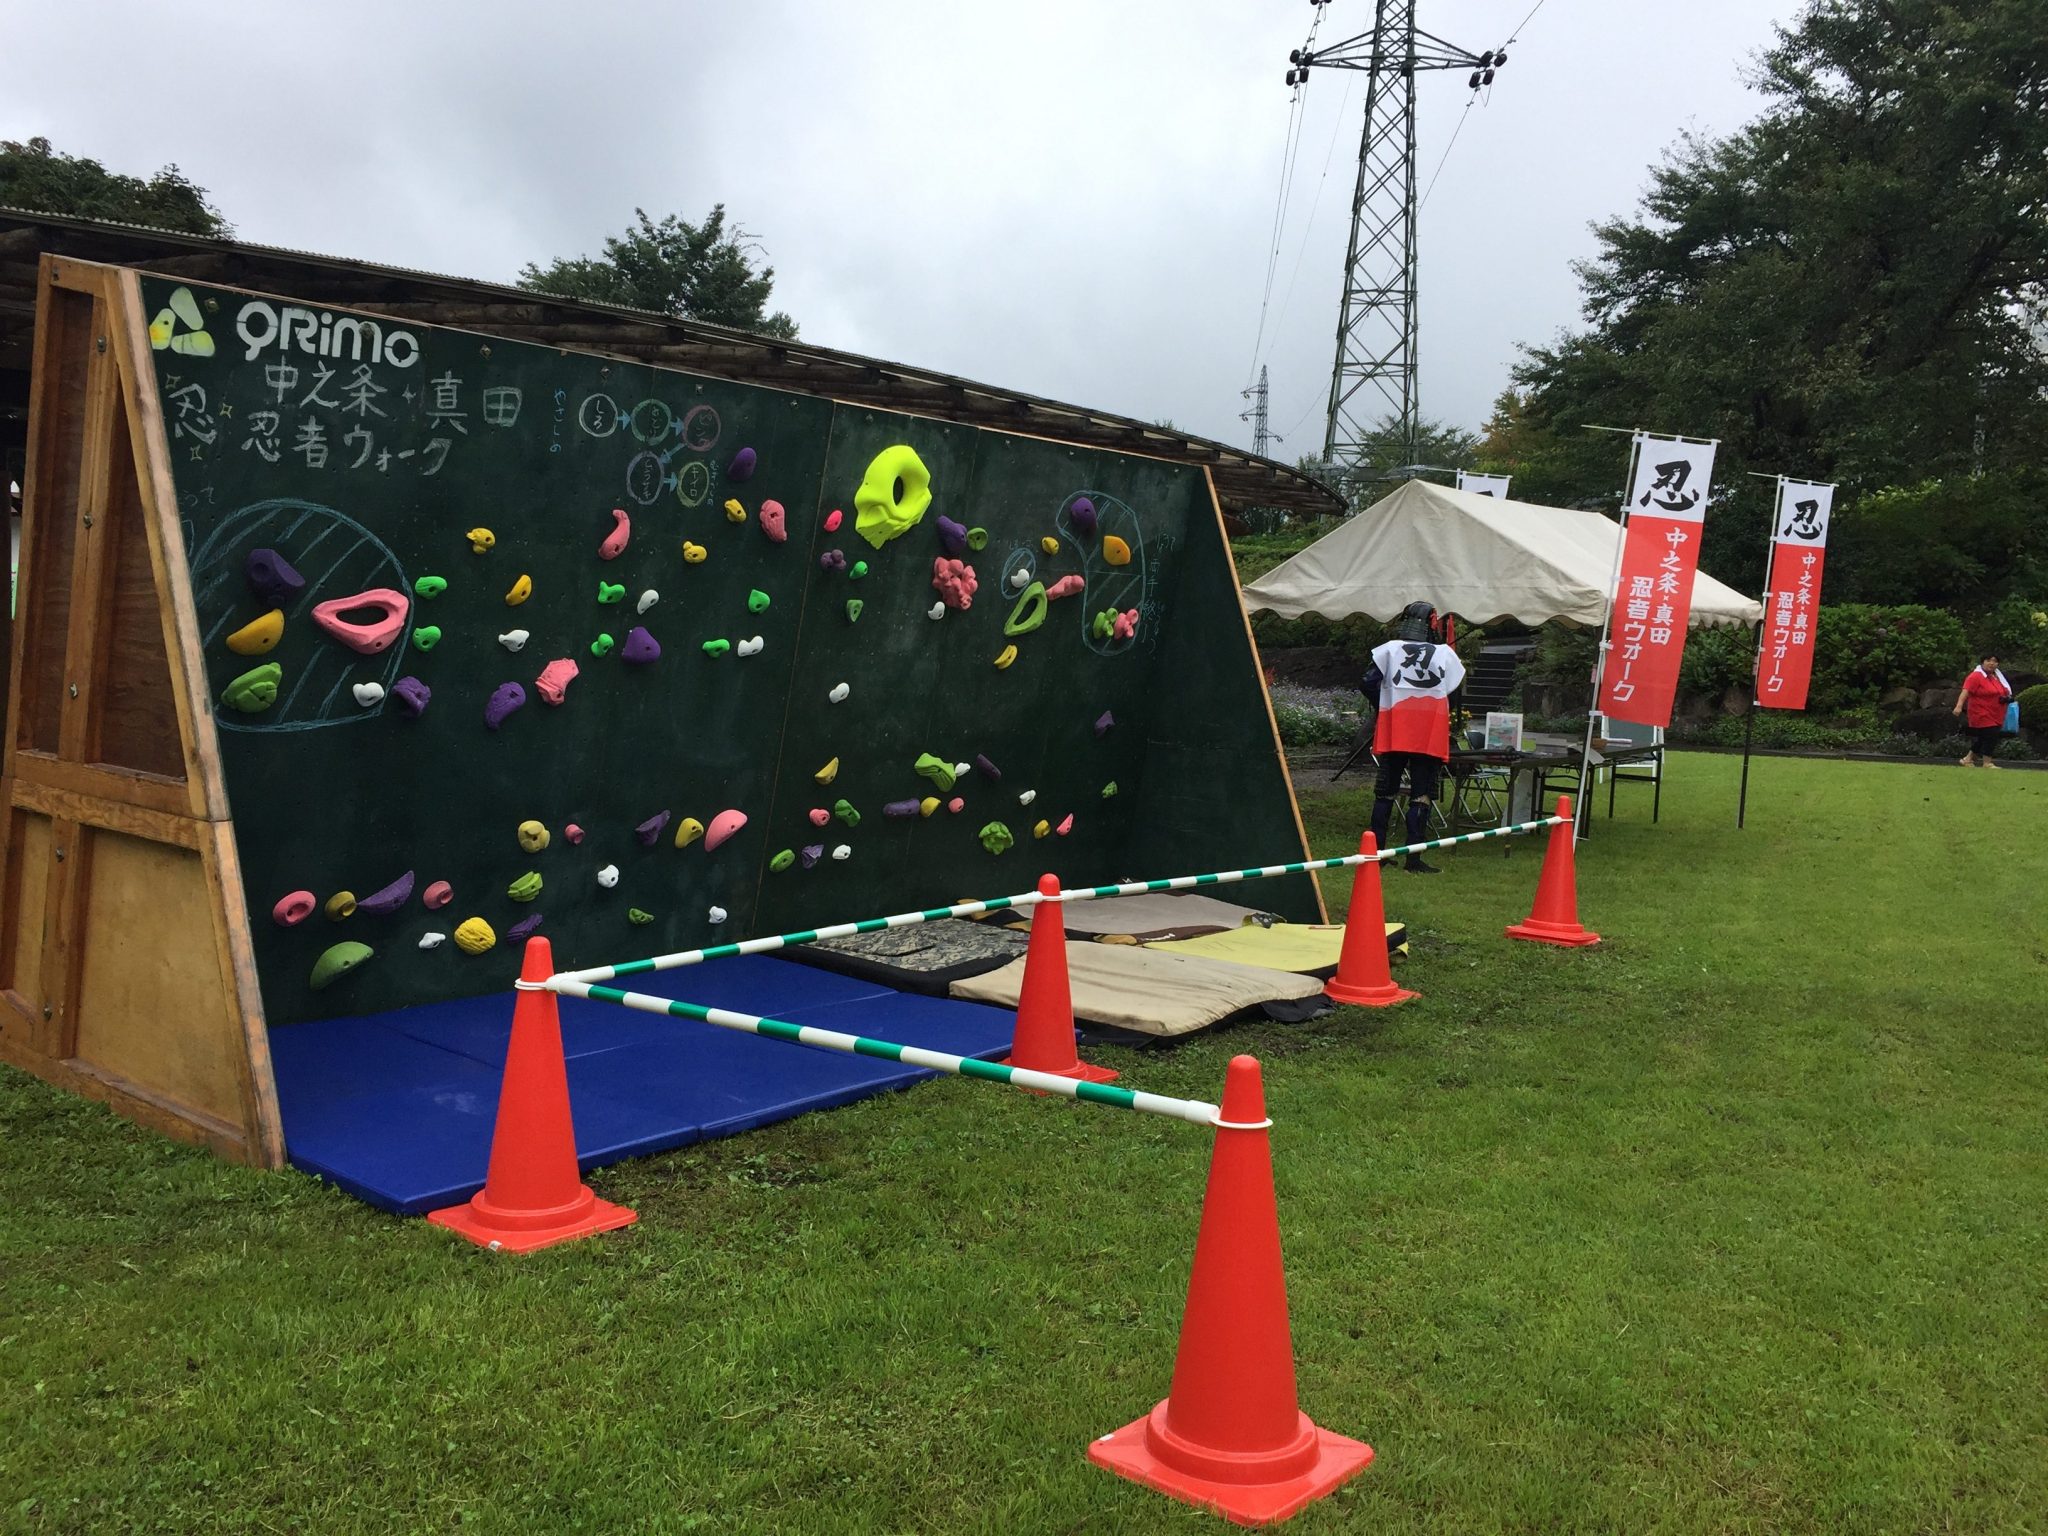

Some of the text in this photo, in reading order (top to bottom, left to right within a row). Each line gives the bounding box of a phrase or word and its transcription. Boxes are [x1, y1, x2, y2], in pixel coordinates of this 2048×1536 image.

[168, 383, 217, 444] 忍
[240, 410, 452, 476] 忍者ウォーク
[1639, 459, 1700, 511] 忍
[1784, 499, 1823, 540] 忍
[1392, 643, 1446, 689] 忍
